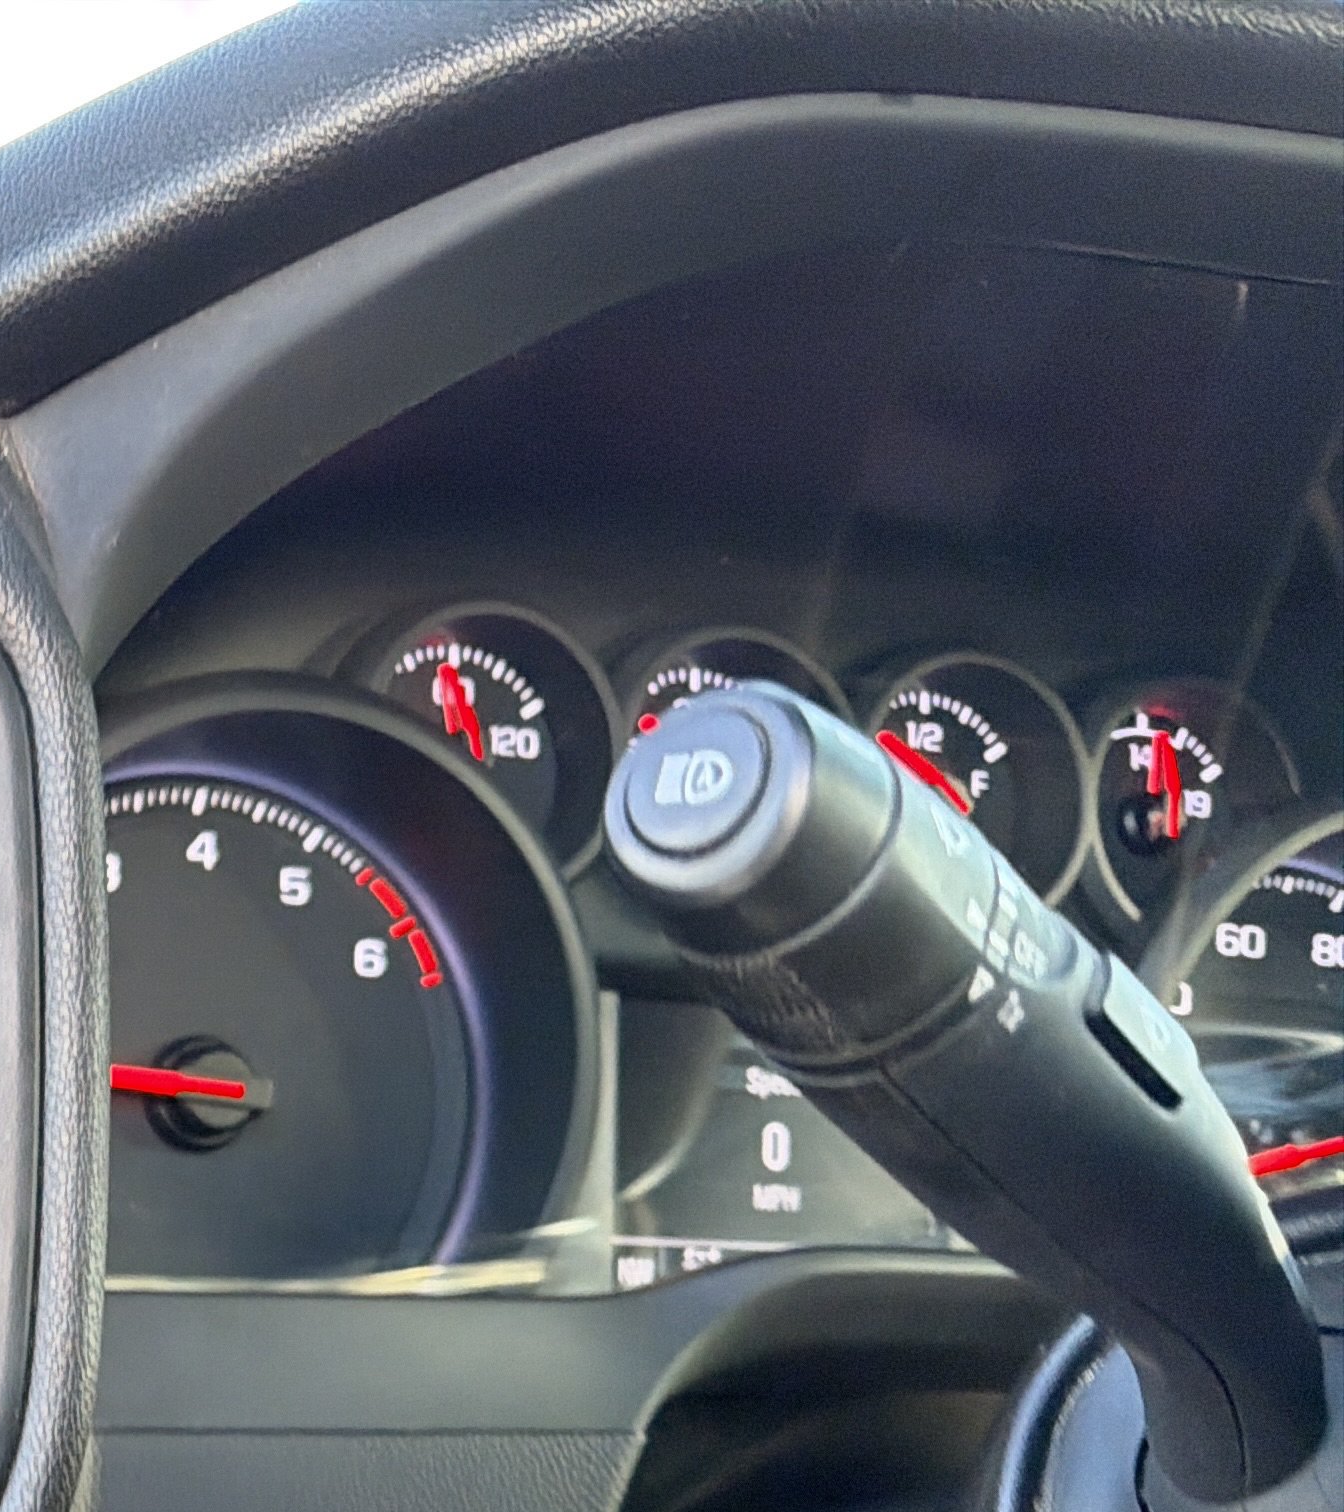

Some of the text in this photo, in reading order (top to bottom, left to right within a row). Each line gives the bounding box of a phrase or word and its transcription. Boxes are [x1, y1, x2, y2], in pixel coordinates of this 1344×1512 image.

[488, 724, 541, 760] 120
[970, 768, 990, 799] F
[1182, 789, 1212, 819] 19
[185, 829, 221, 871] 4
[278, 865, 313, 907] 5
[352, 936, 389, 978] 6
[1215, 922, 1267, 960] 60
[761, 1120, 792, 1173] 0
